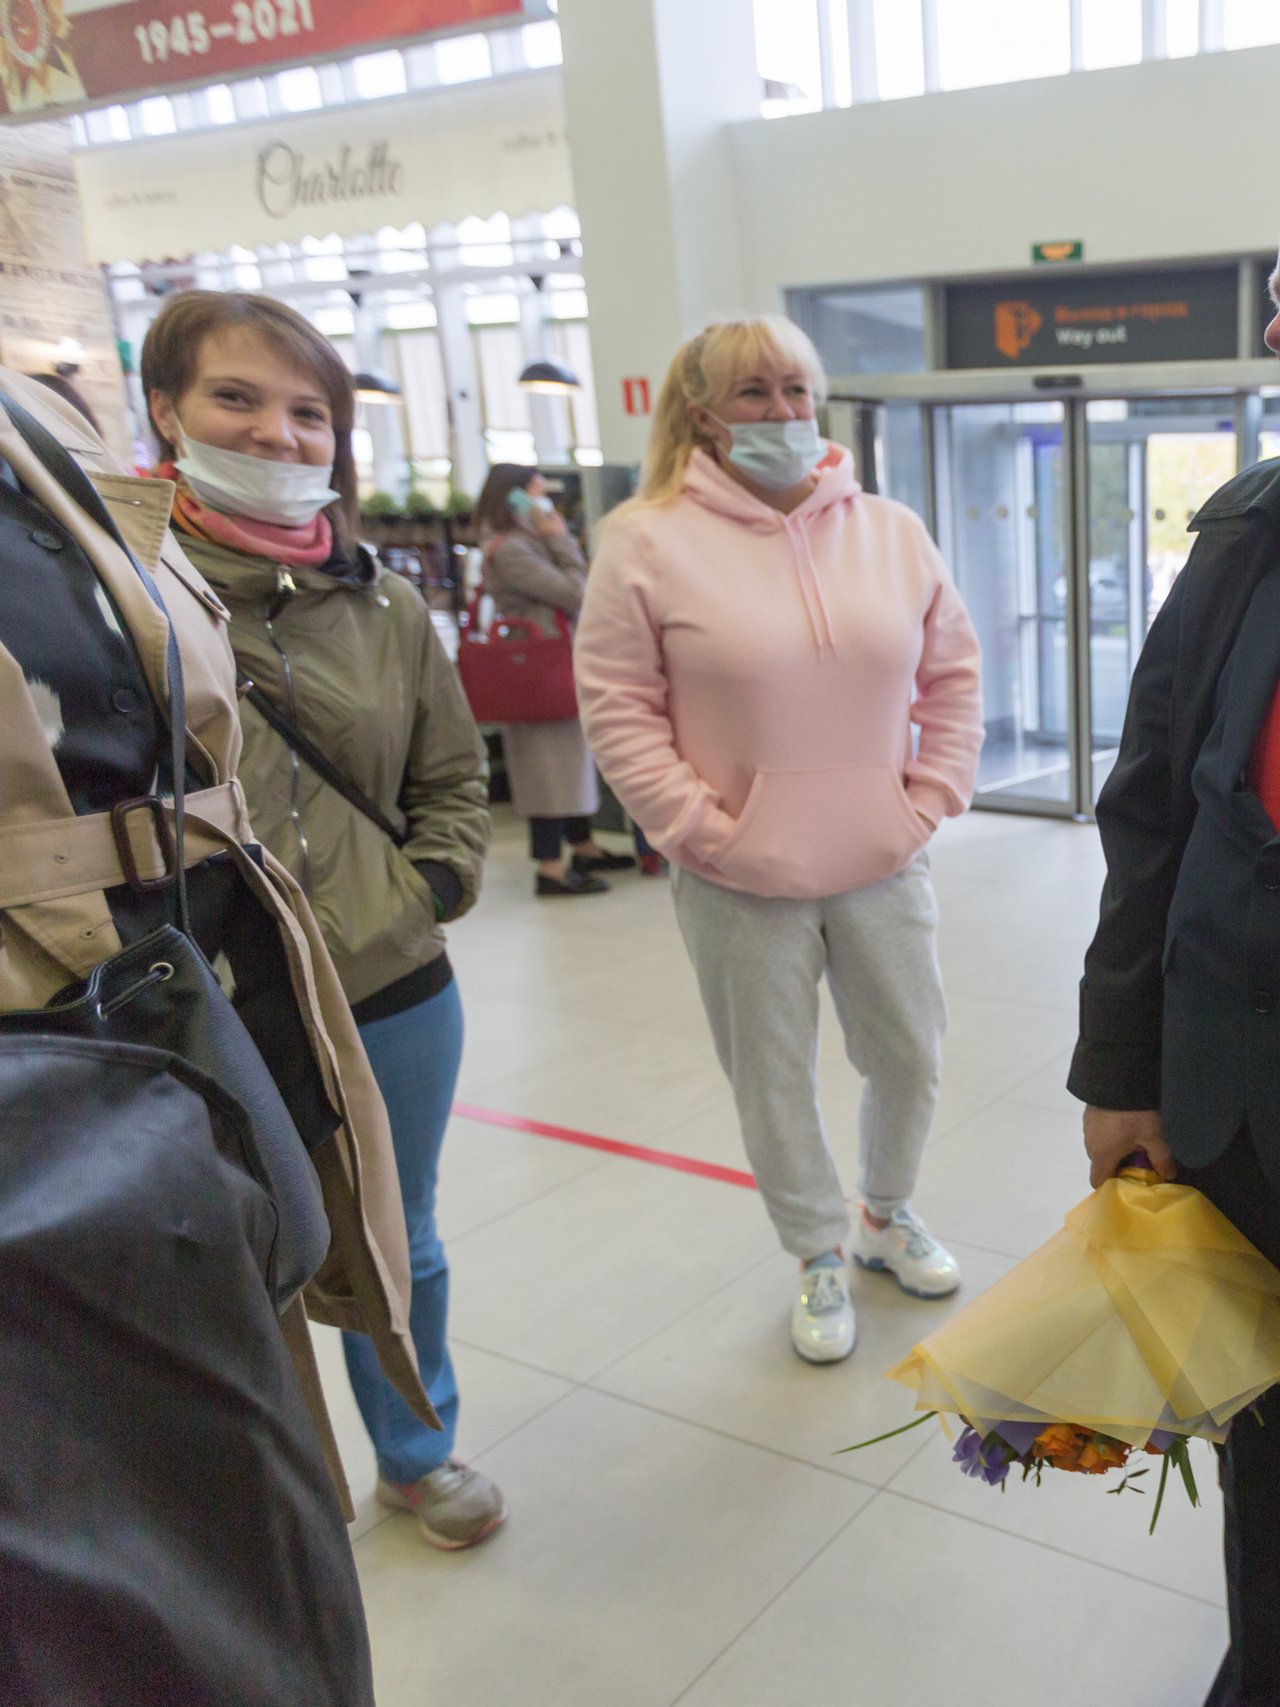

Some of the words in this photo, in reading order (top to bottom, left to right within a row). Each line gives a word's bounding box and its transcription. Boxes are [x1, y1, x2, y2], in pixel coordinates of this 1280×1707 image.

[256, 140, 405, 219] Charlotte
[1055, 327, 1094, 350] Way
[1095, 325, 1128, 344] out
